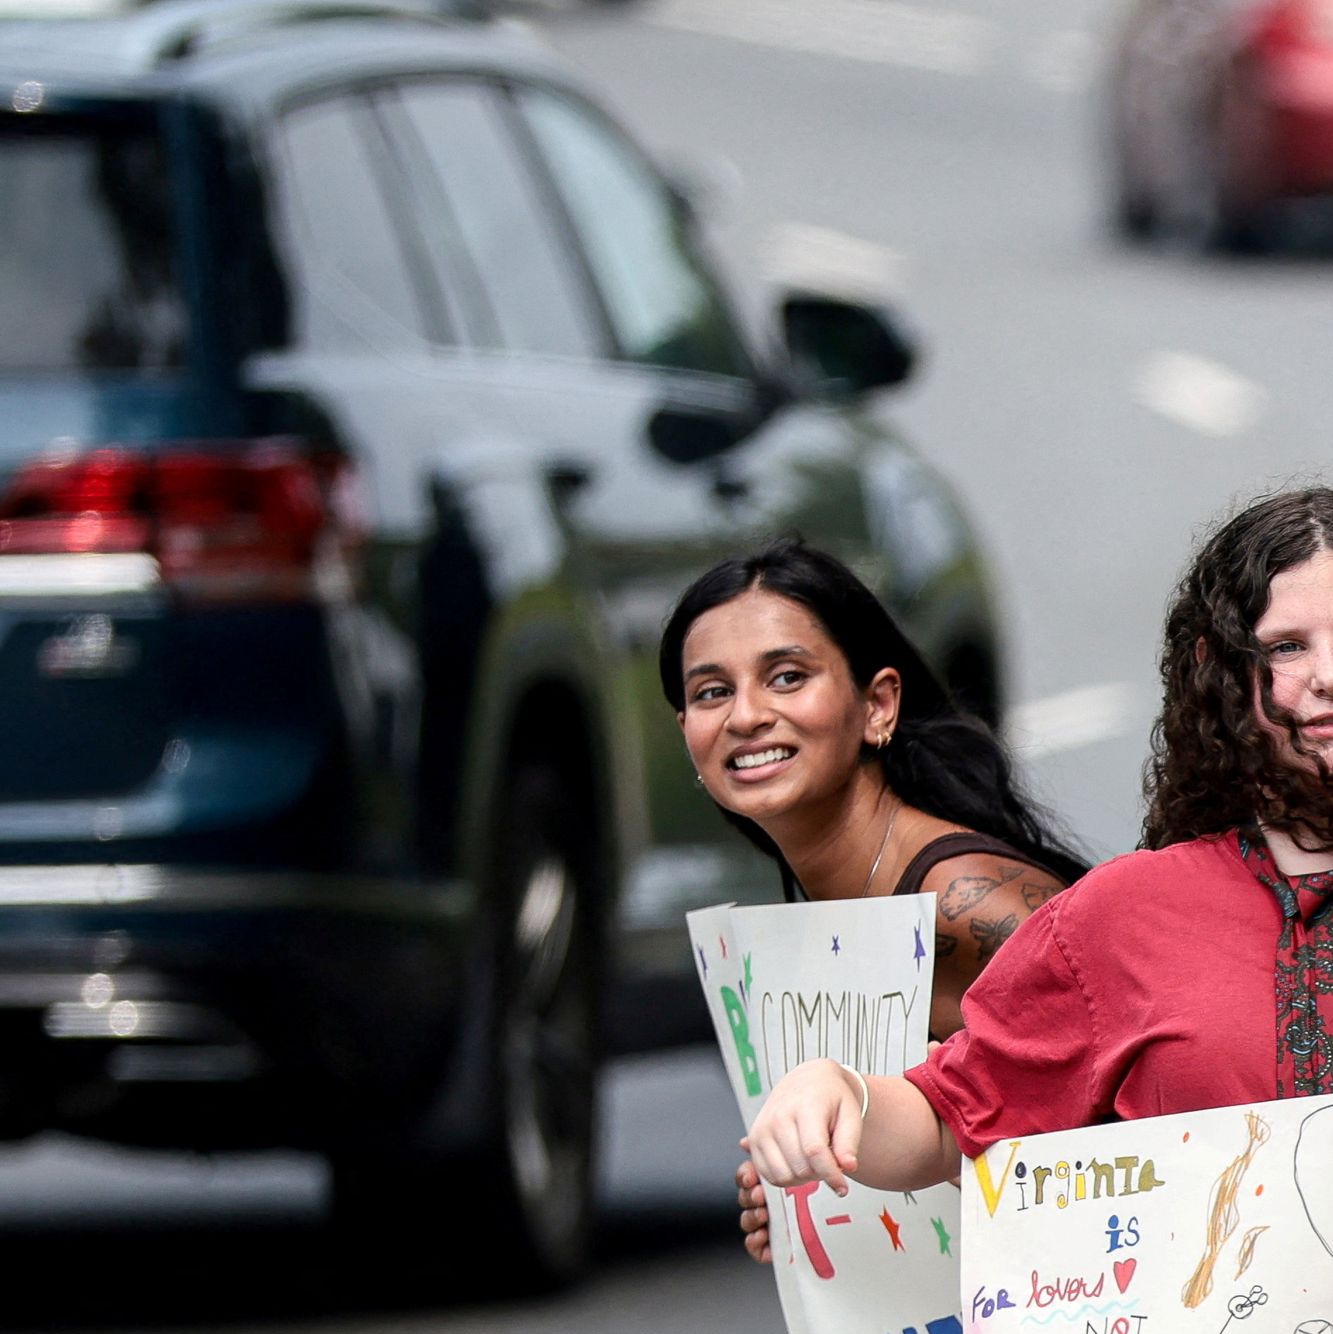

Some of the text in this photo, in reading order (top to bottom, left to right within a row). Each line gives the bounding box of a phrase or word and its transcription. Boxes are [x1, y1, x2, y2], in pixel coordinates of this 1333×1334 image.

[762, 985, 917, 1089] COMMUNITY
[1106, 1215, 1139, 1252] is
[972, 1270, 1104, 1323] FOR lovers
